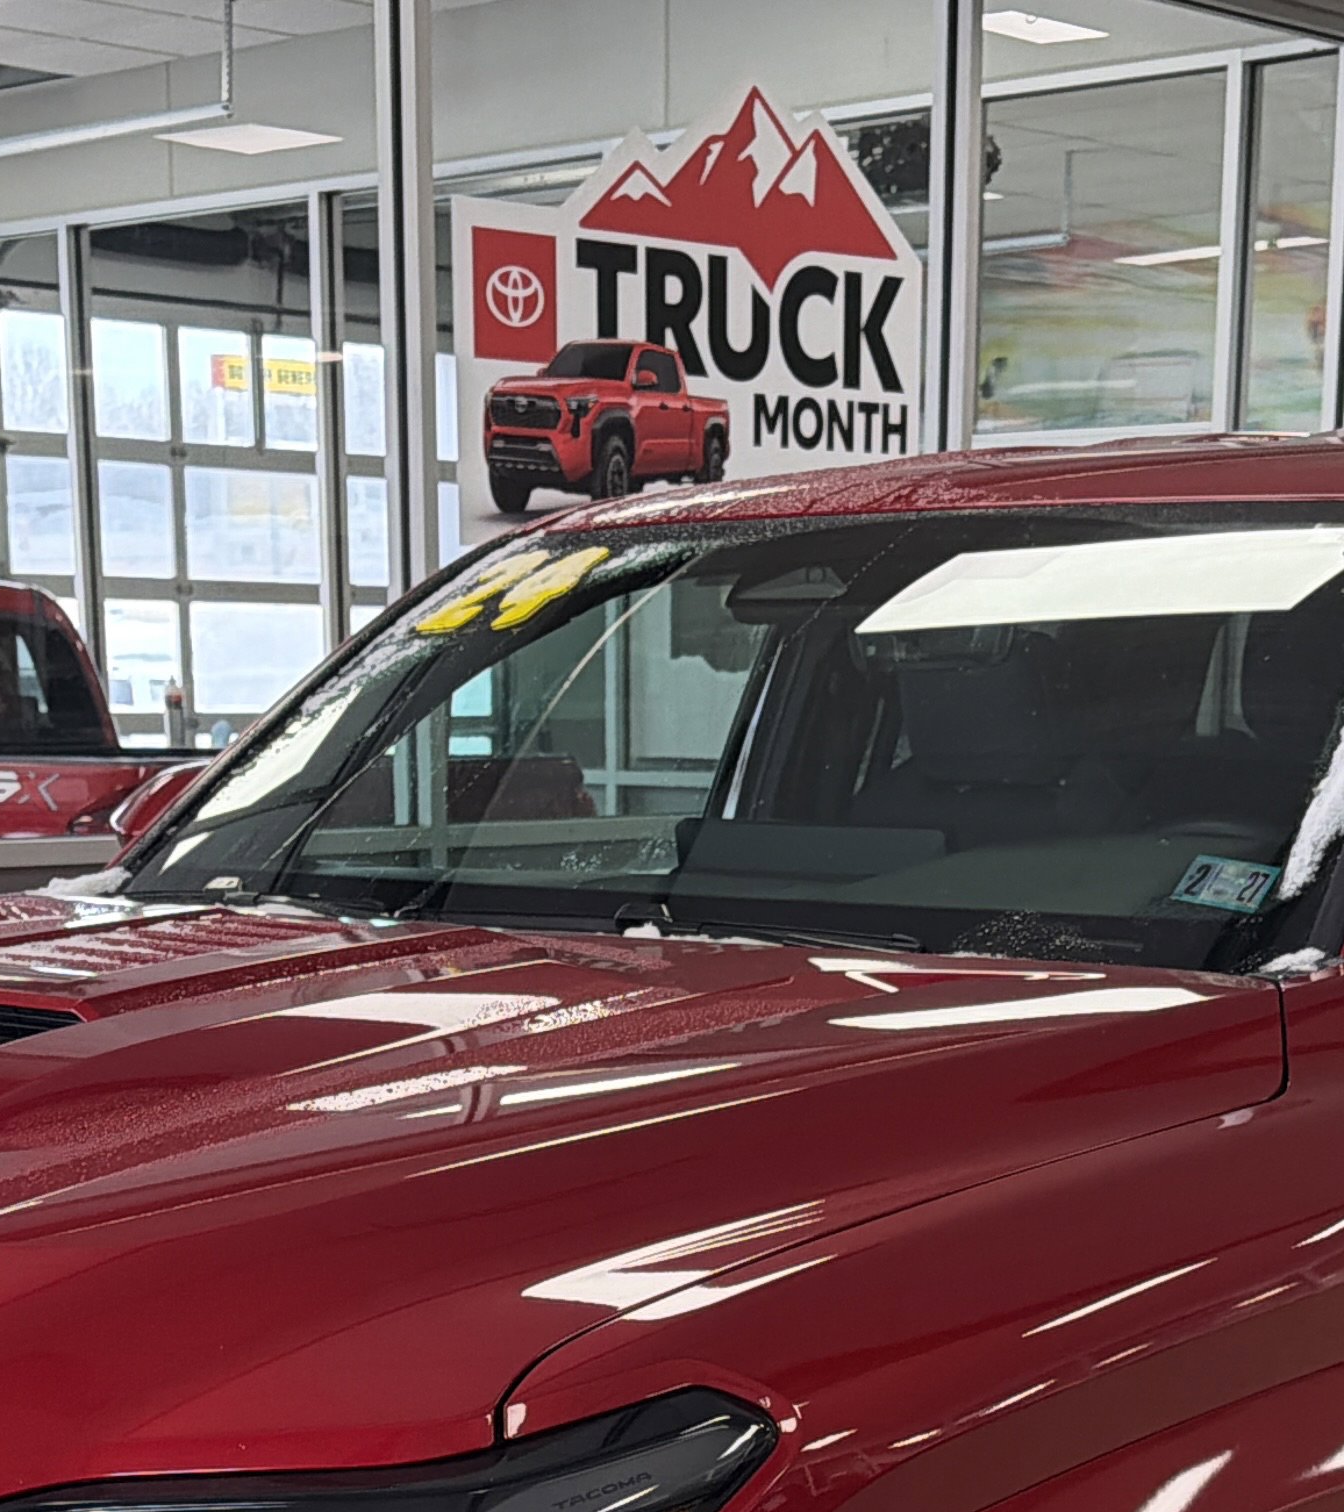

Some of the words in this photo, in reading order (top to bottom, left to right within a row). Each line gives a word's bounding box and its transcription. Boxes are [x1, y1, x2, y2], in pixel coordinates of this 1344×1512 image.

[575, 236, 904, 394] TRUCK
[752, 393, 908, 455] MONTH
[1184, 864, 1213, 896] 2
[1236, 871, 1271, 903] 27
[551, 1471, 653, 1510] TACOMA
